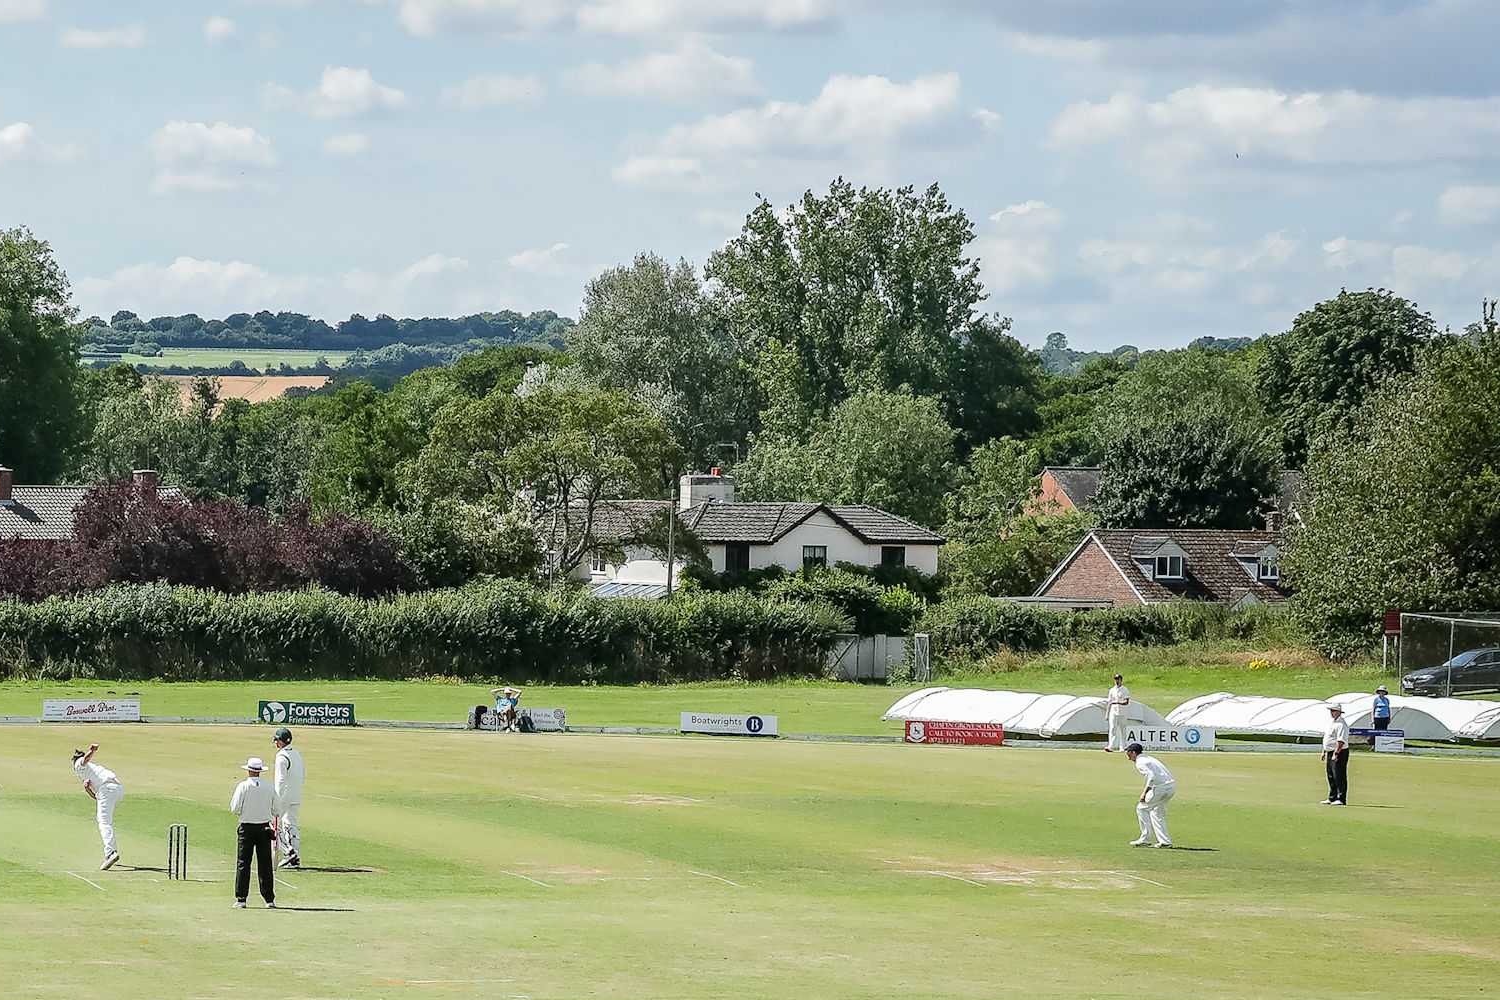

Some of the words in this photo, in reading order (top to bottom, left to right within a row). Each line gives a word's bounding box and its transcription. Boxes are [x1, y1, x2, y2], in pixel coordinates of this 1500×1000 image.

[66, 704, 96, 716] Boswell
[98, 702, 117, 713] Bros.
[288, 703, 350, 718] Foresters
[288, 715, 320, 725] Friendly
[320, 716, 349, 725] Society
[691, 715, 742, 727] Boatwrights
[1127, 730, 1179, 742] ALTER
